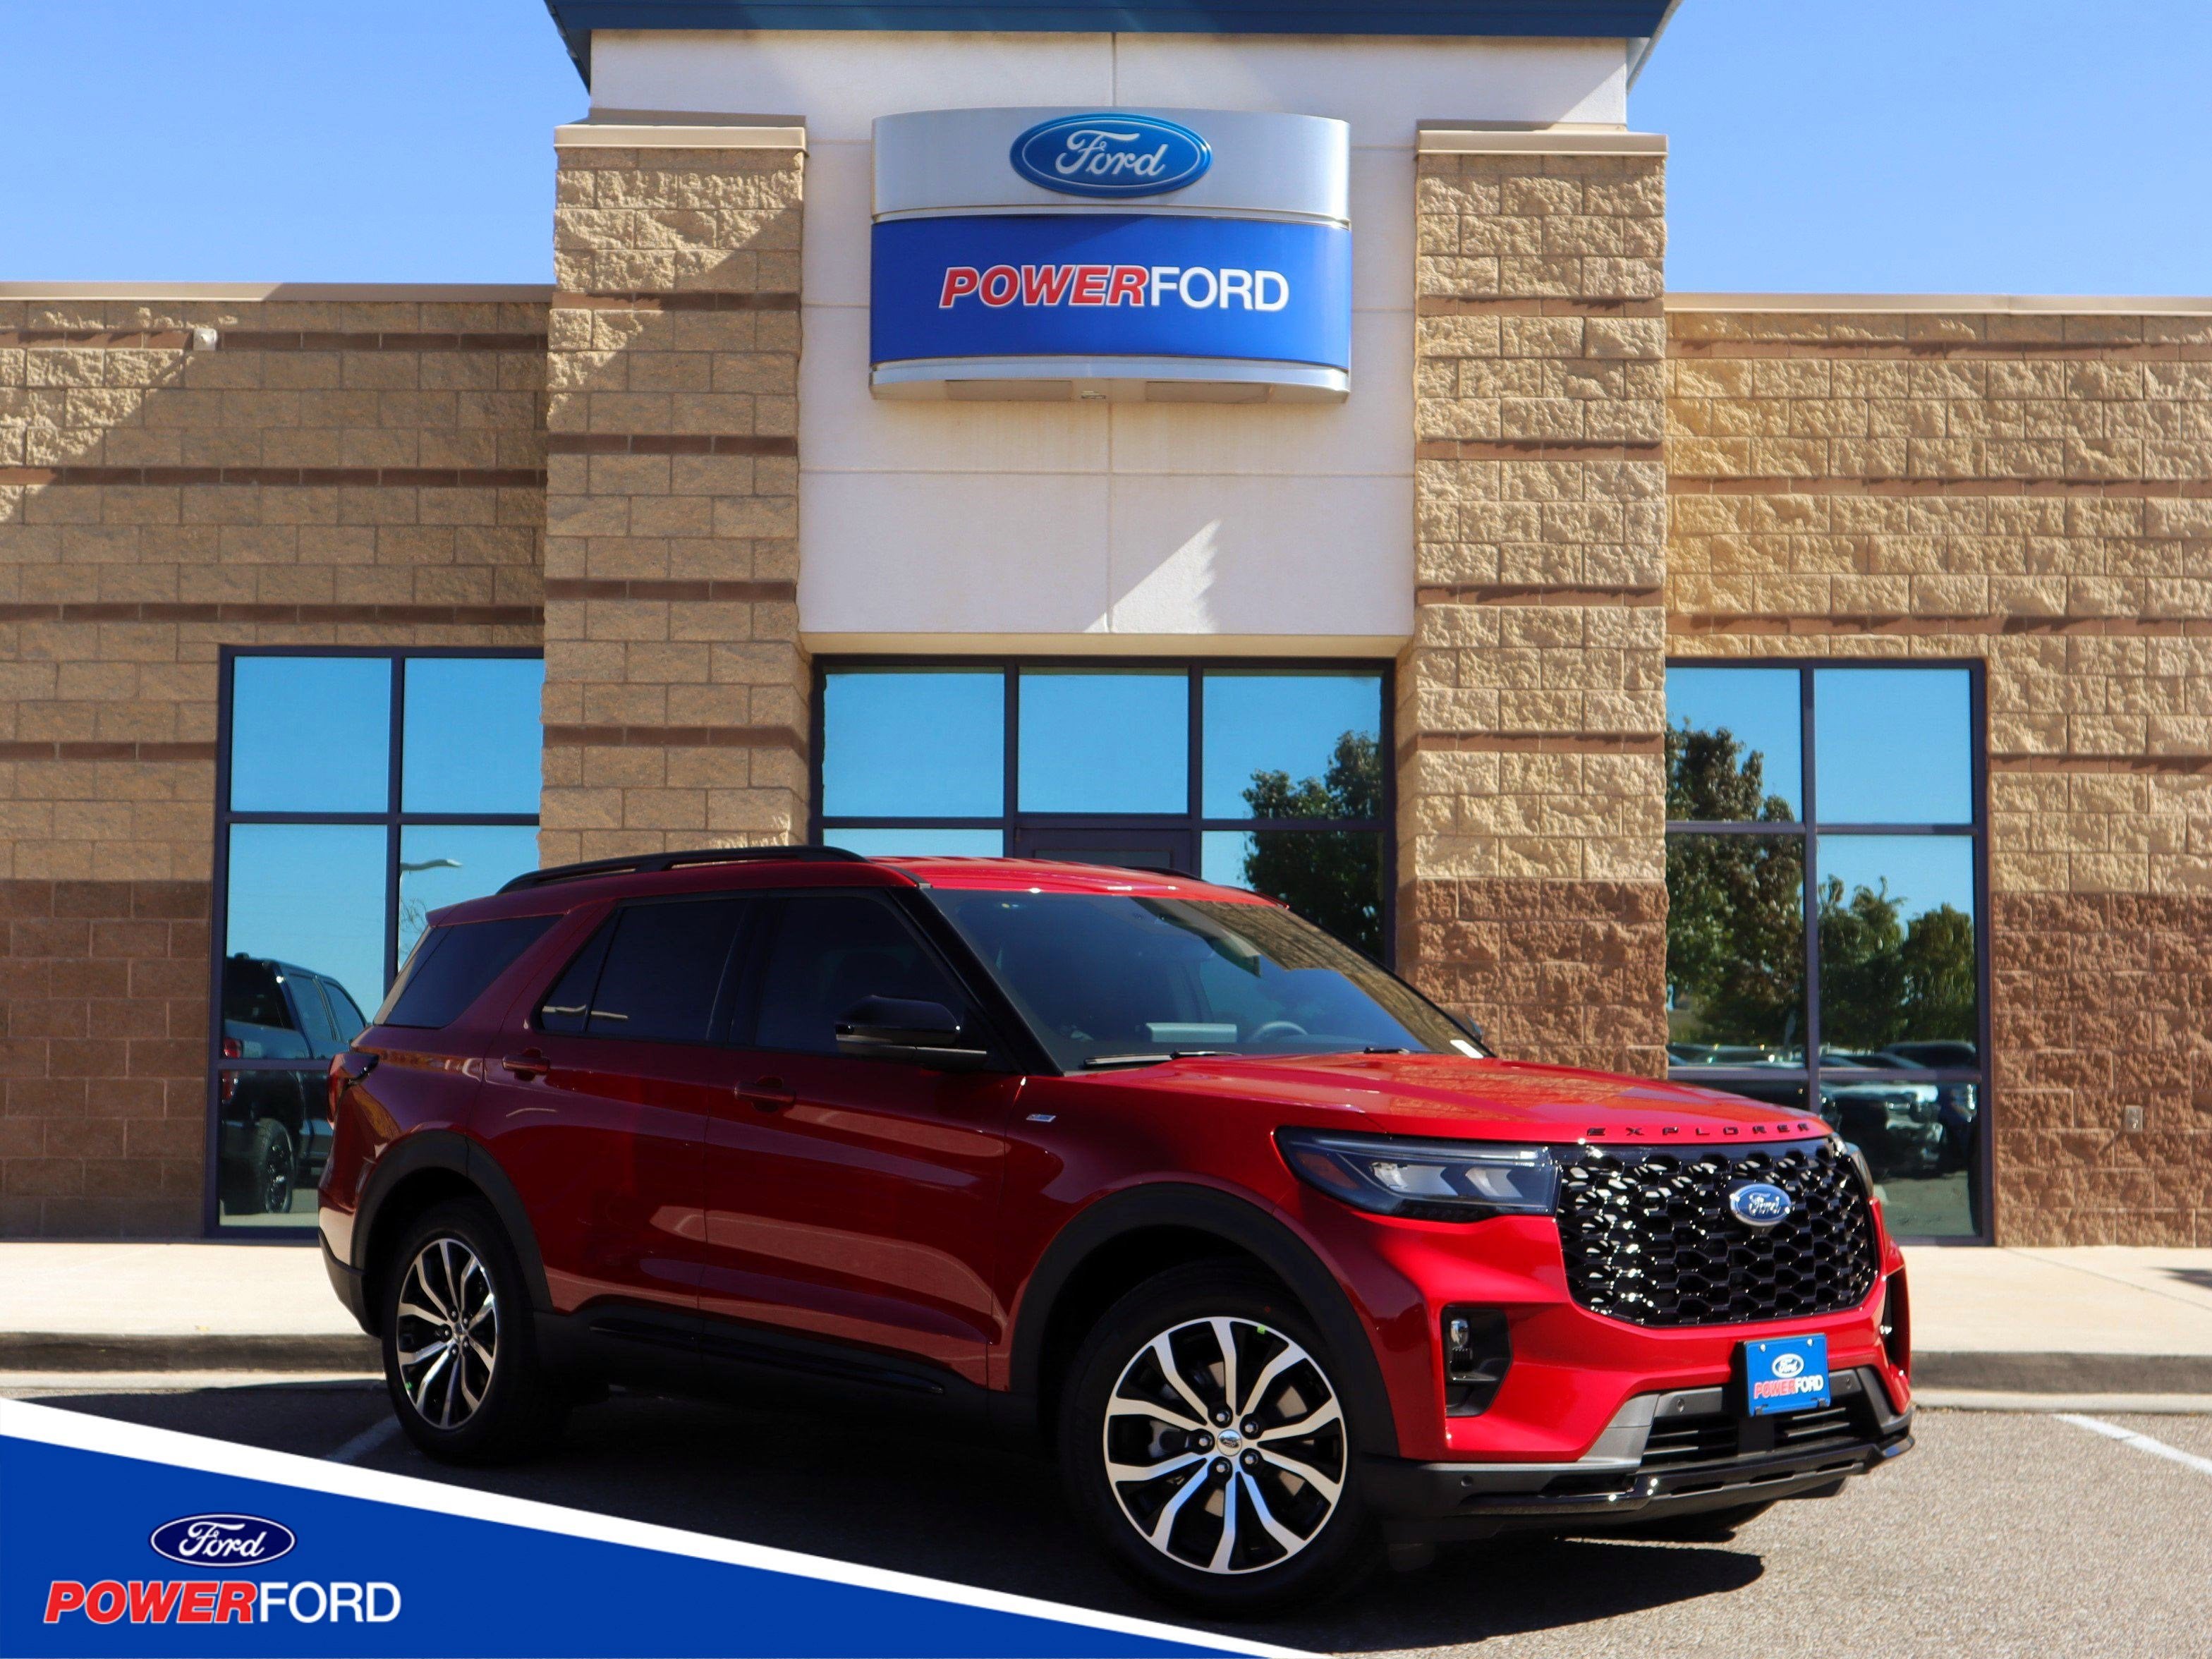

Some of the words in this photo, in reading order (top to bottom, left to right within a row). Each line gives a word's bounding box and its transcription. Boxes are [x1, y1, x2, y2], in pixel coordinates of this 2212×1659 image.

[1056, 130, 1167, 176] Ford
[1587, 1123, 1809, 1136] EXPLORER
[1749, 1192, 1781, 1216] Ford
